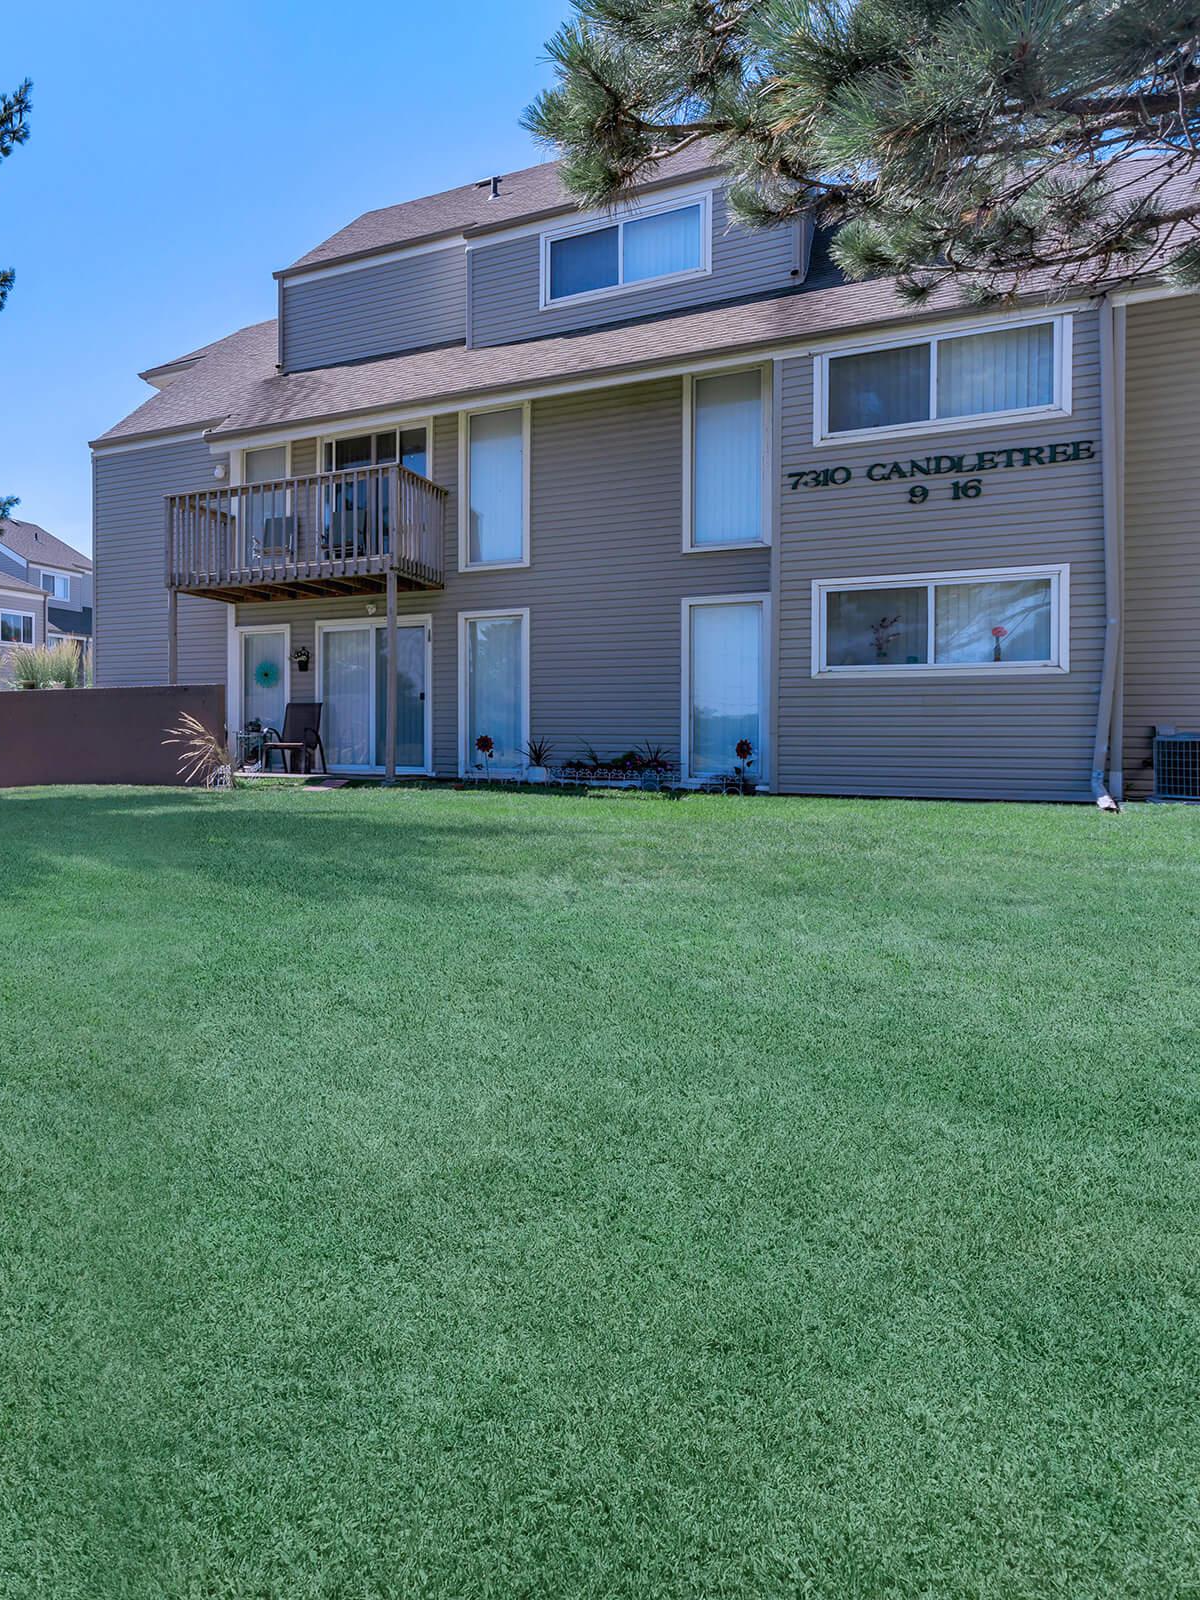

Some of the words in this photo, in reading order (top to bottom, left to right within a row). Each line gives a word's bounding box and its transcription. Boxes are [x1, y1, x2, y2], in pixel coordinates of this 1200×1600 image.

[787, 466, 851, 490] 7310
[866, 440, 1095, 482] CANDLETREE
[908, 485, 929, 504] 9
[951, 479, 982, 500] 16
